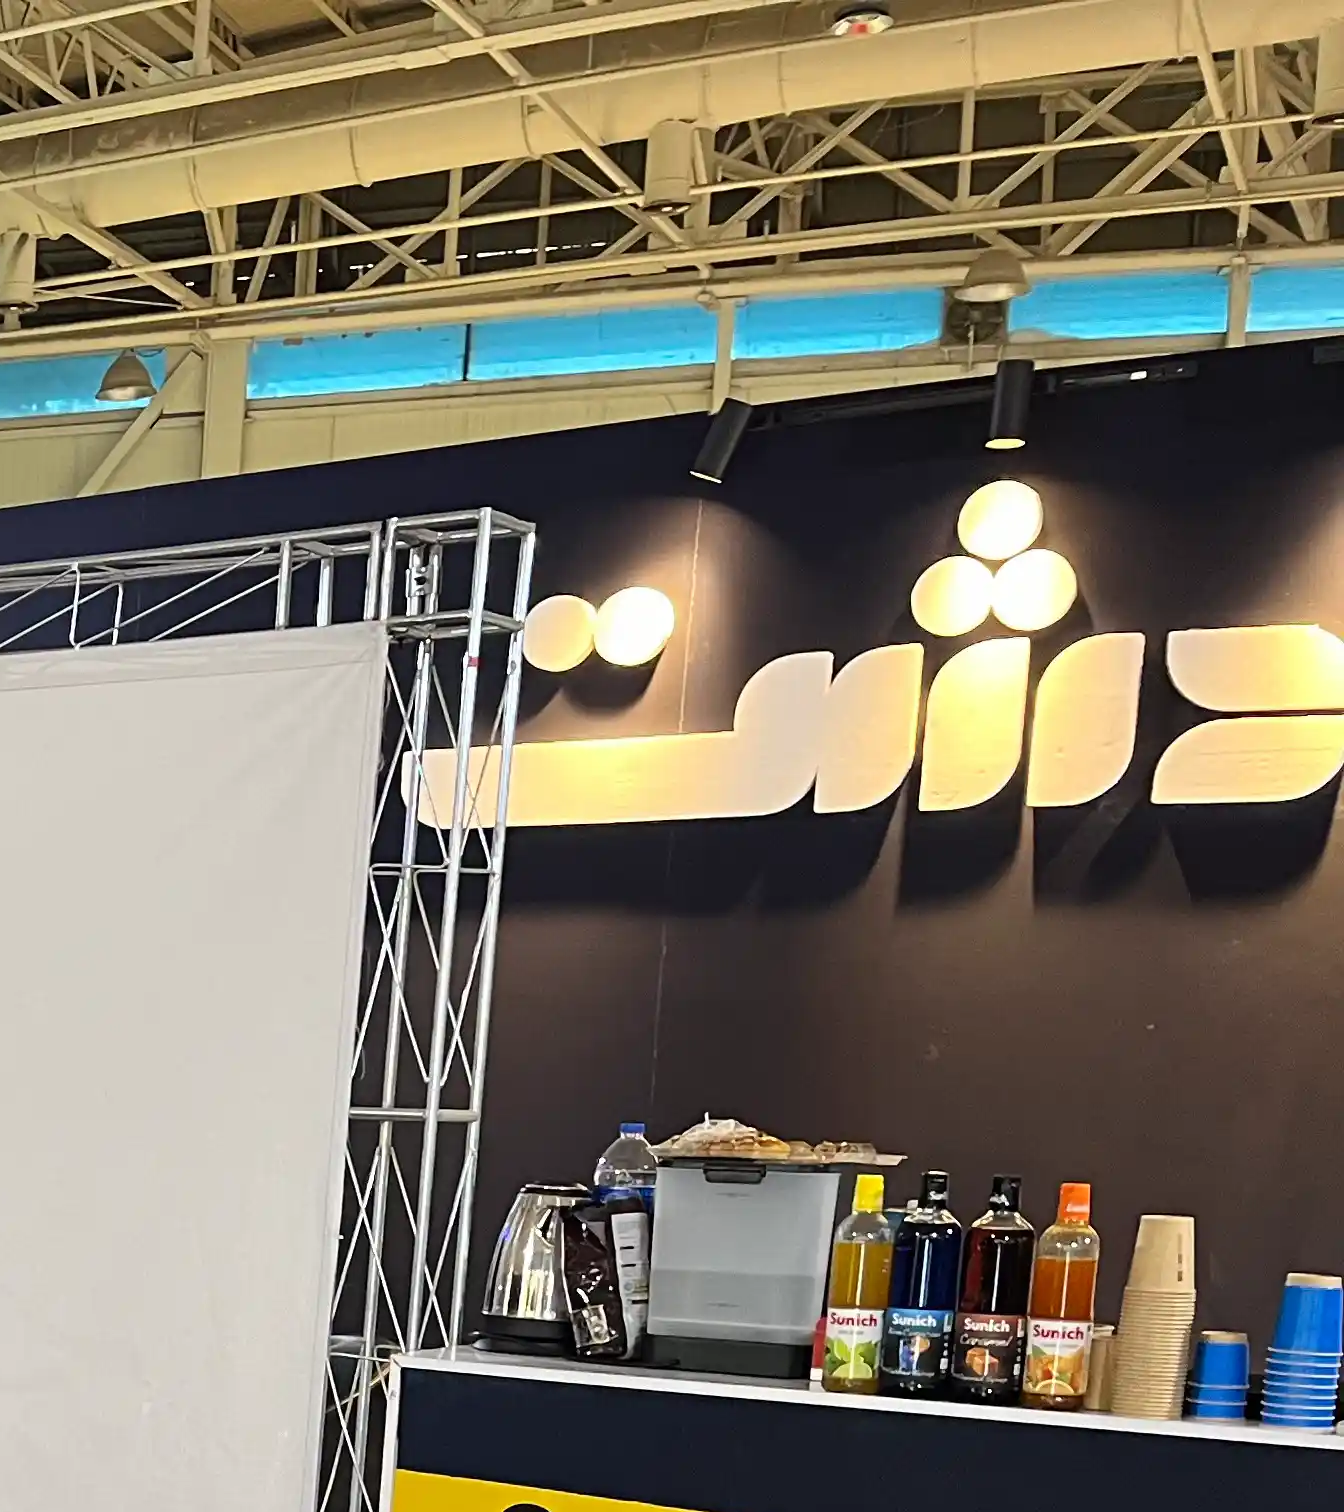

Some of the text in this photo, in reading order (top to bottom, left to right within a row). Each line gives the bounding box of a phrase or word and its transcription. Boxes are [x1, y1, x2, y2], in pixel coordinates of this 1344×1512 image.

[829, 1311, 878, 1327] Sunich
[892, 1312, 937, 1328] Sunich
[964, 1317, 1011, 1333] Sunich
[1032, 1323, 1085, 1340] Sunich
